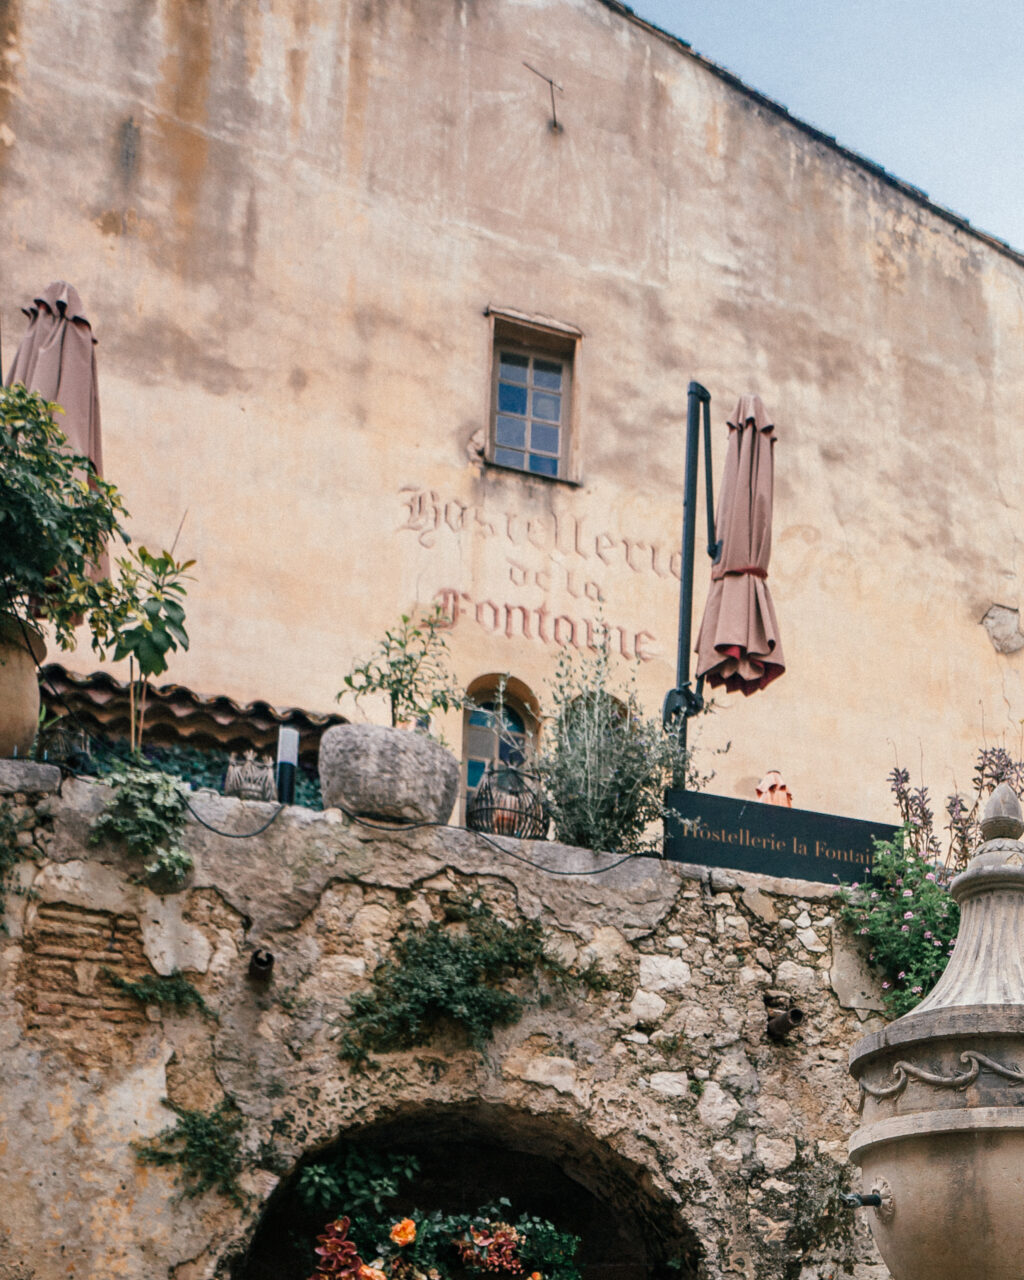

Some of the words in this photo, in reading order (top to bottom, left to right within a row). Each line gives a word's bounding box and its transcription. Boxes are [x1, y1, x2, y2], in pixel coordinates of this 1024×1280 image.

[565, 569, 605, 603] la
[418, 588, 660, 662] Fontaine
[793, 837, 808, 856] la
[815, 840, 877, 865] Fontai
